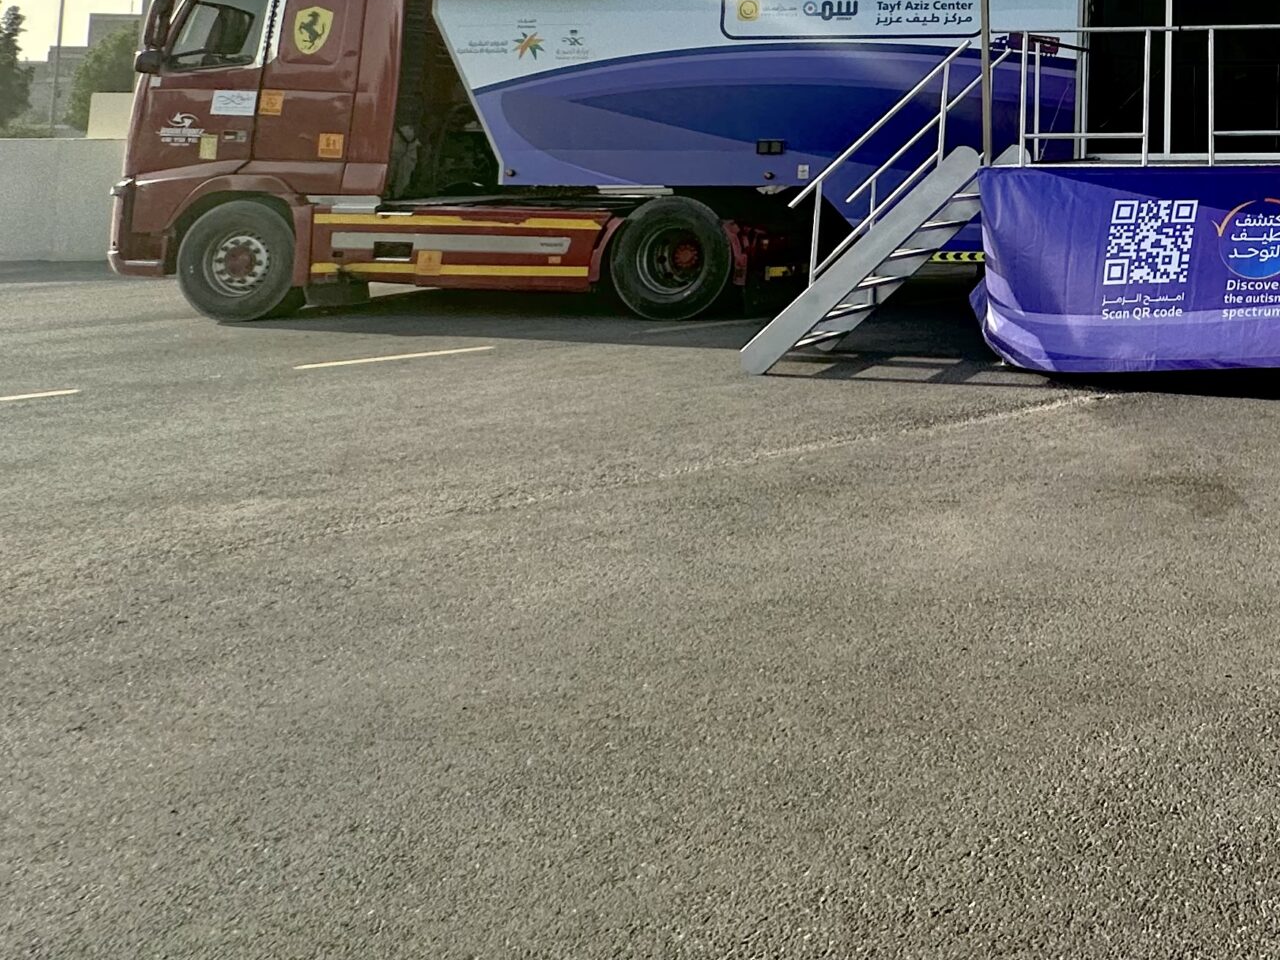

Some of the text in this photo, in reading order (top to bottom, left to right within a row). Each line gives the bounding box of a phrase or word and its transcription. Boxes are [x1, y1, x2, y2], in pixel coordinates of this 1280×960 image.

[876, 1, 973, 13] Tayf Aziz Center
[875, 12, 973, 26] مركز طيف عزيز
[1101, 292, 1185, 306] امسح الرمز
[1224, 293, 1244, 304] the
[1101, 306, 1183, 320] Scan QR code
